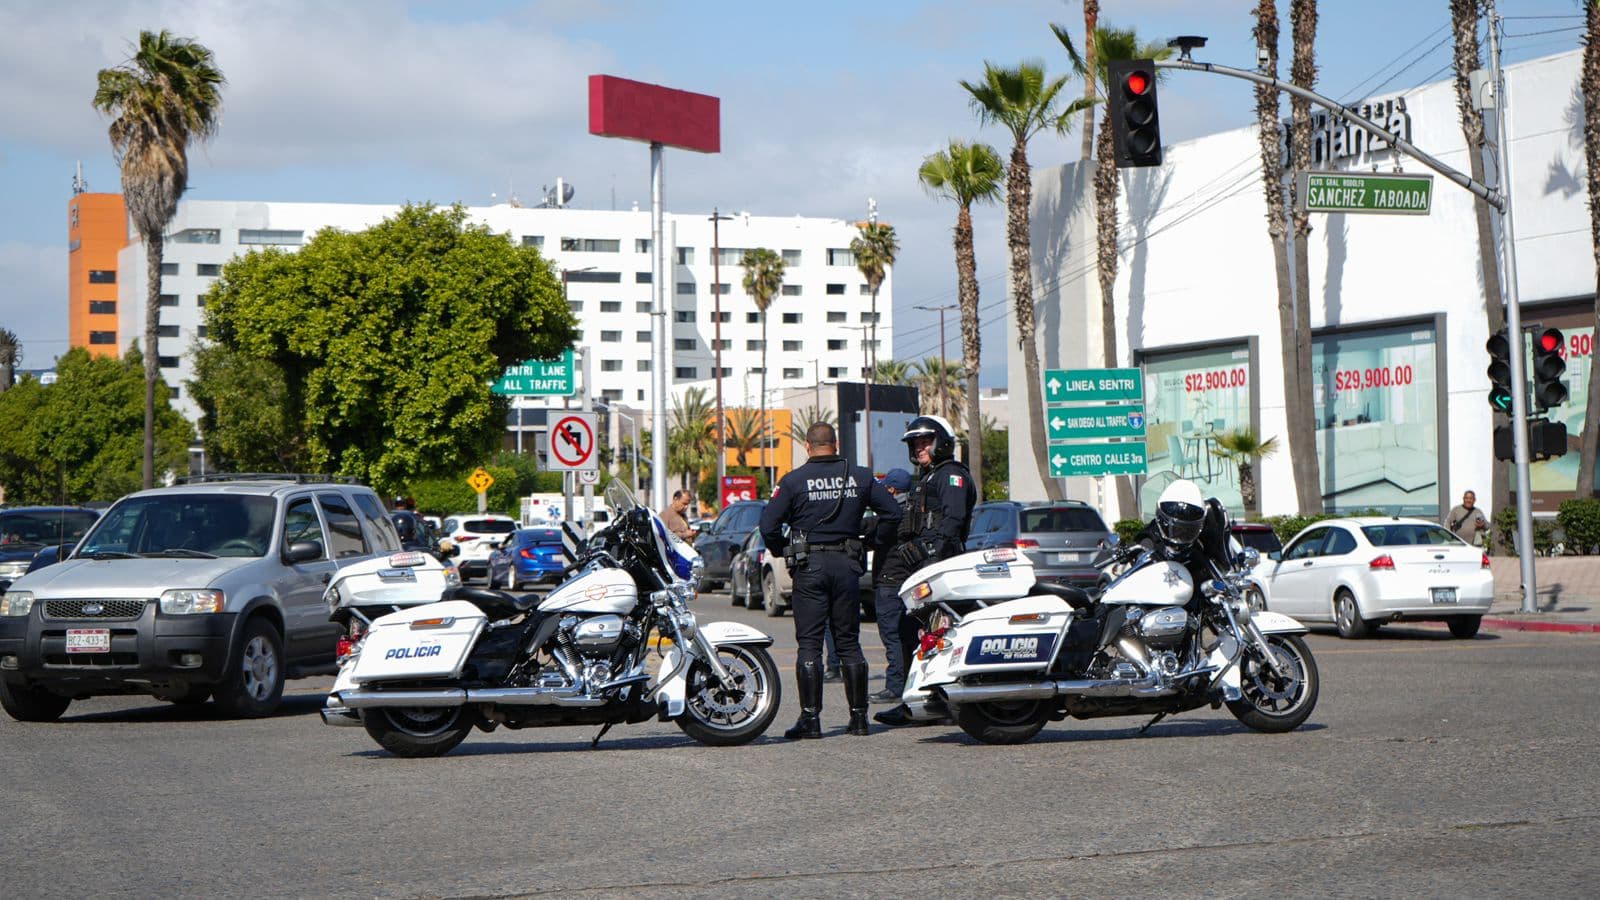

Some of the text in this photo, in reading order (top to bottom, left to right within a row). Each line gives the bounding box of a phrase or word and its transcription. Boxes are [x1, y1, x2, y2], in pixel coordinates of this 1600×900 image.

[1309, 187, 1427, 208] SANCHEZ TABOADA
[541, 365, 566, 376] LANE
[503, 379, 567, 391] ALL TRAFFIC
[1185, 368, 1246, 394] $12,900.00
[1335, 364, 1413, 392] $29,900.00
[1066, 379, 1135, 392] LINEA SENTRI
[1067, 415, 1127, 428] SAN DIEGO ALL TRAFFIC
[1070, 453, 1143, 466] CENTRO CALLE 3ra
[384, 645, 442, 660] POLICIA
[980, 638, 1038, 655] POLICIA
